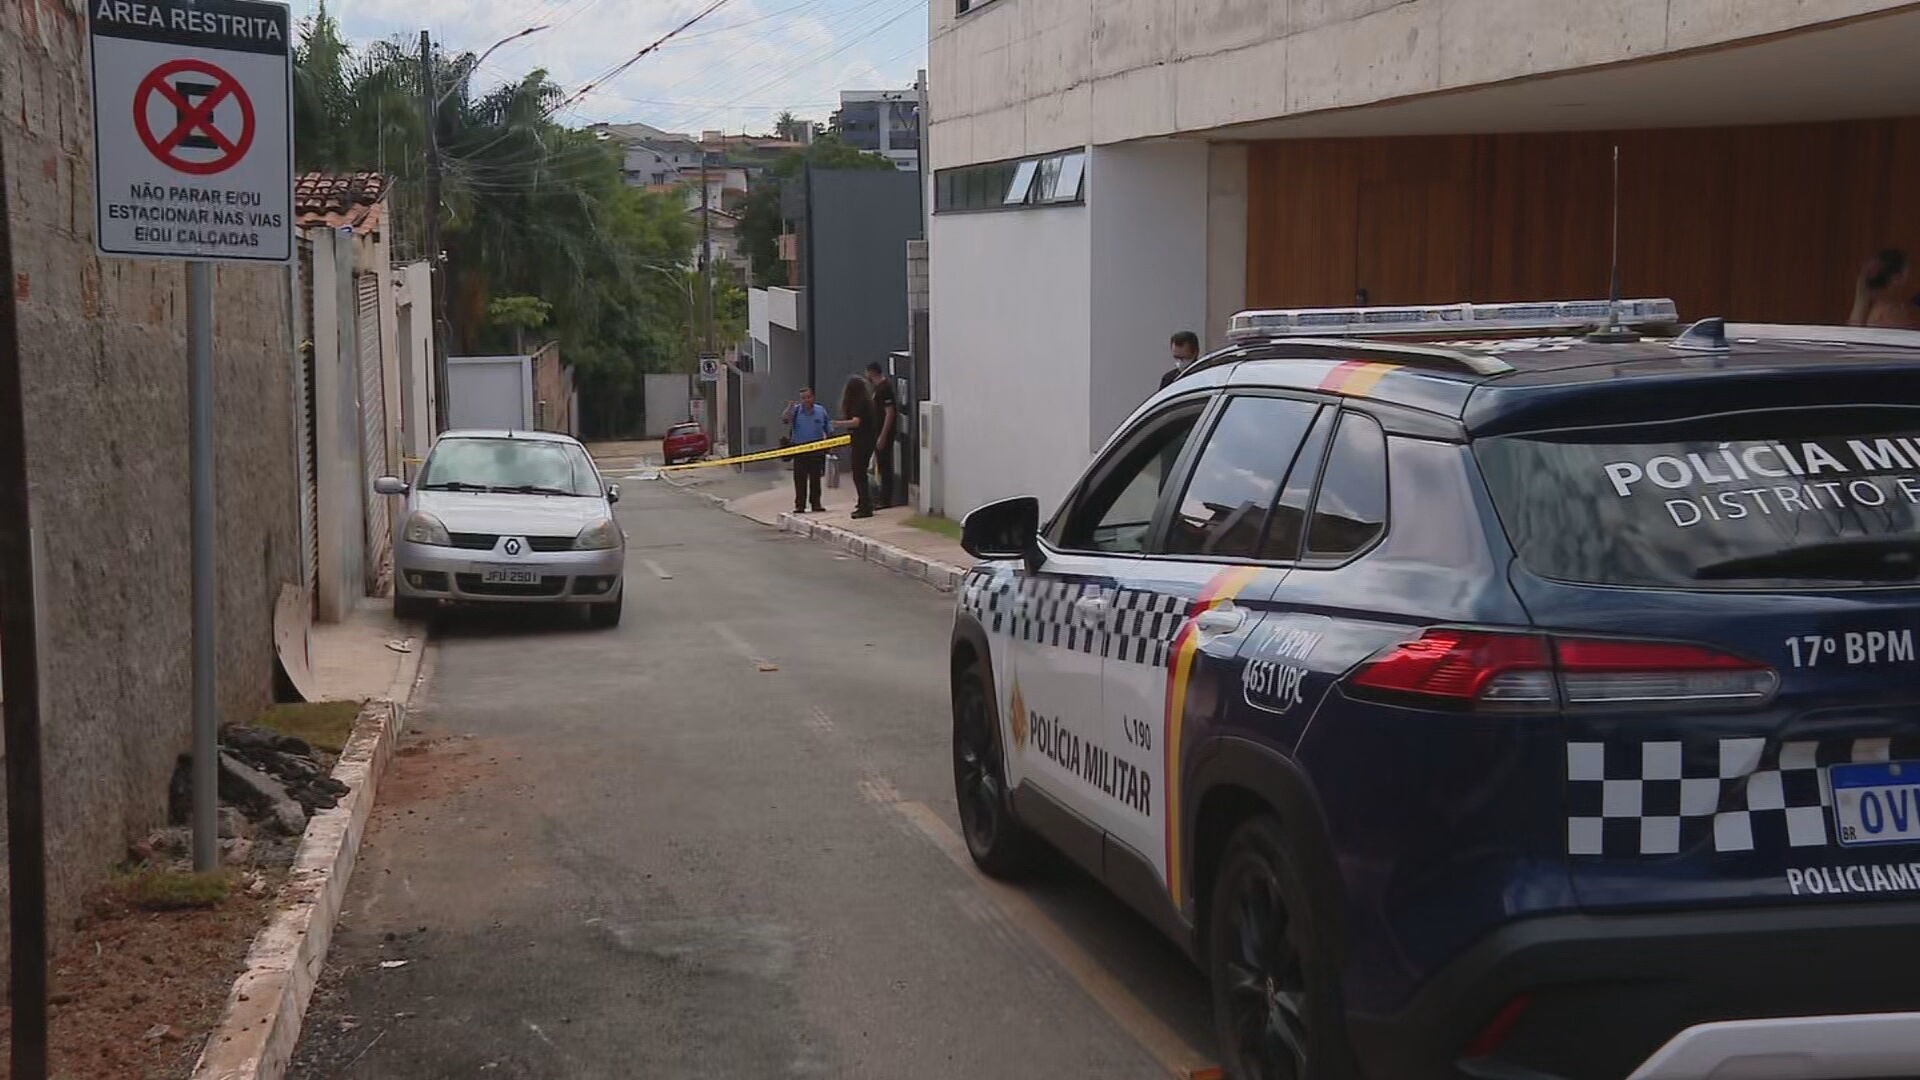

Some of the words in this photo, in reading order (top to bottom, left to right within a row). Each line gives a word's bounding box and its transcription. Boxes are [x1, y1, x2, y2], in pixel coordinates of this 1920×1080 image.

[171, 8, 281, 40] RESTRITA
[130, 182, 164, 200] NÃO
[169, 186, 221, 204] PARAR
[225, 190, 261, 206] E/OU
[109, 204, 208, 223] ESTACIONAR
[213, 210, 244, 225] NAS
[249, 213, 281, 228] VIAS
[177, 231, 259, 247] CALÇADAS
[1604, 442, 1849, 497] POLÍCIA
[1664, 480, 1886, 527] DISTRITO
[1845, 629, 1915, 664] BPM
[1276, 663, 1308, 704] VPC
[1133, 718, 1152, 751] 190
[1029, 710, 1081, 777] POLÍCIA
[1083, 741, 1150, 816] MILITAR
[1842, 826, 1857, 841] BR
